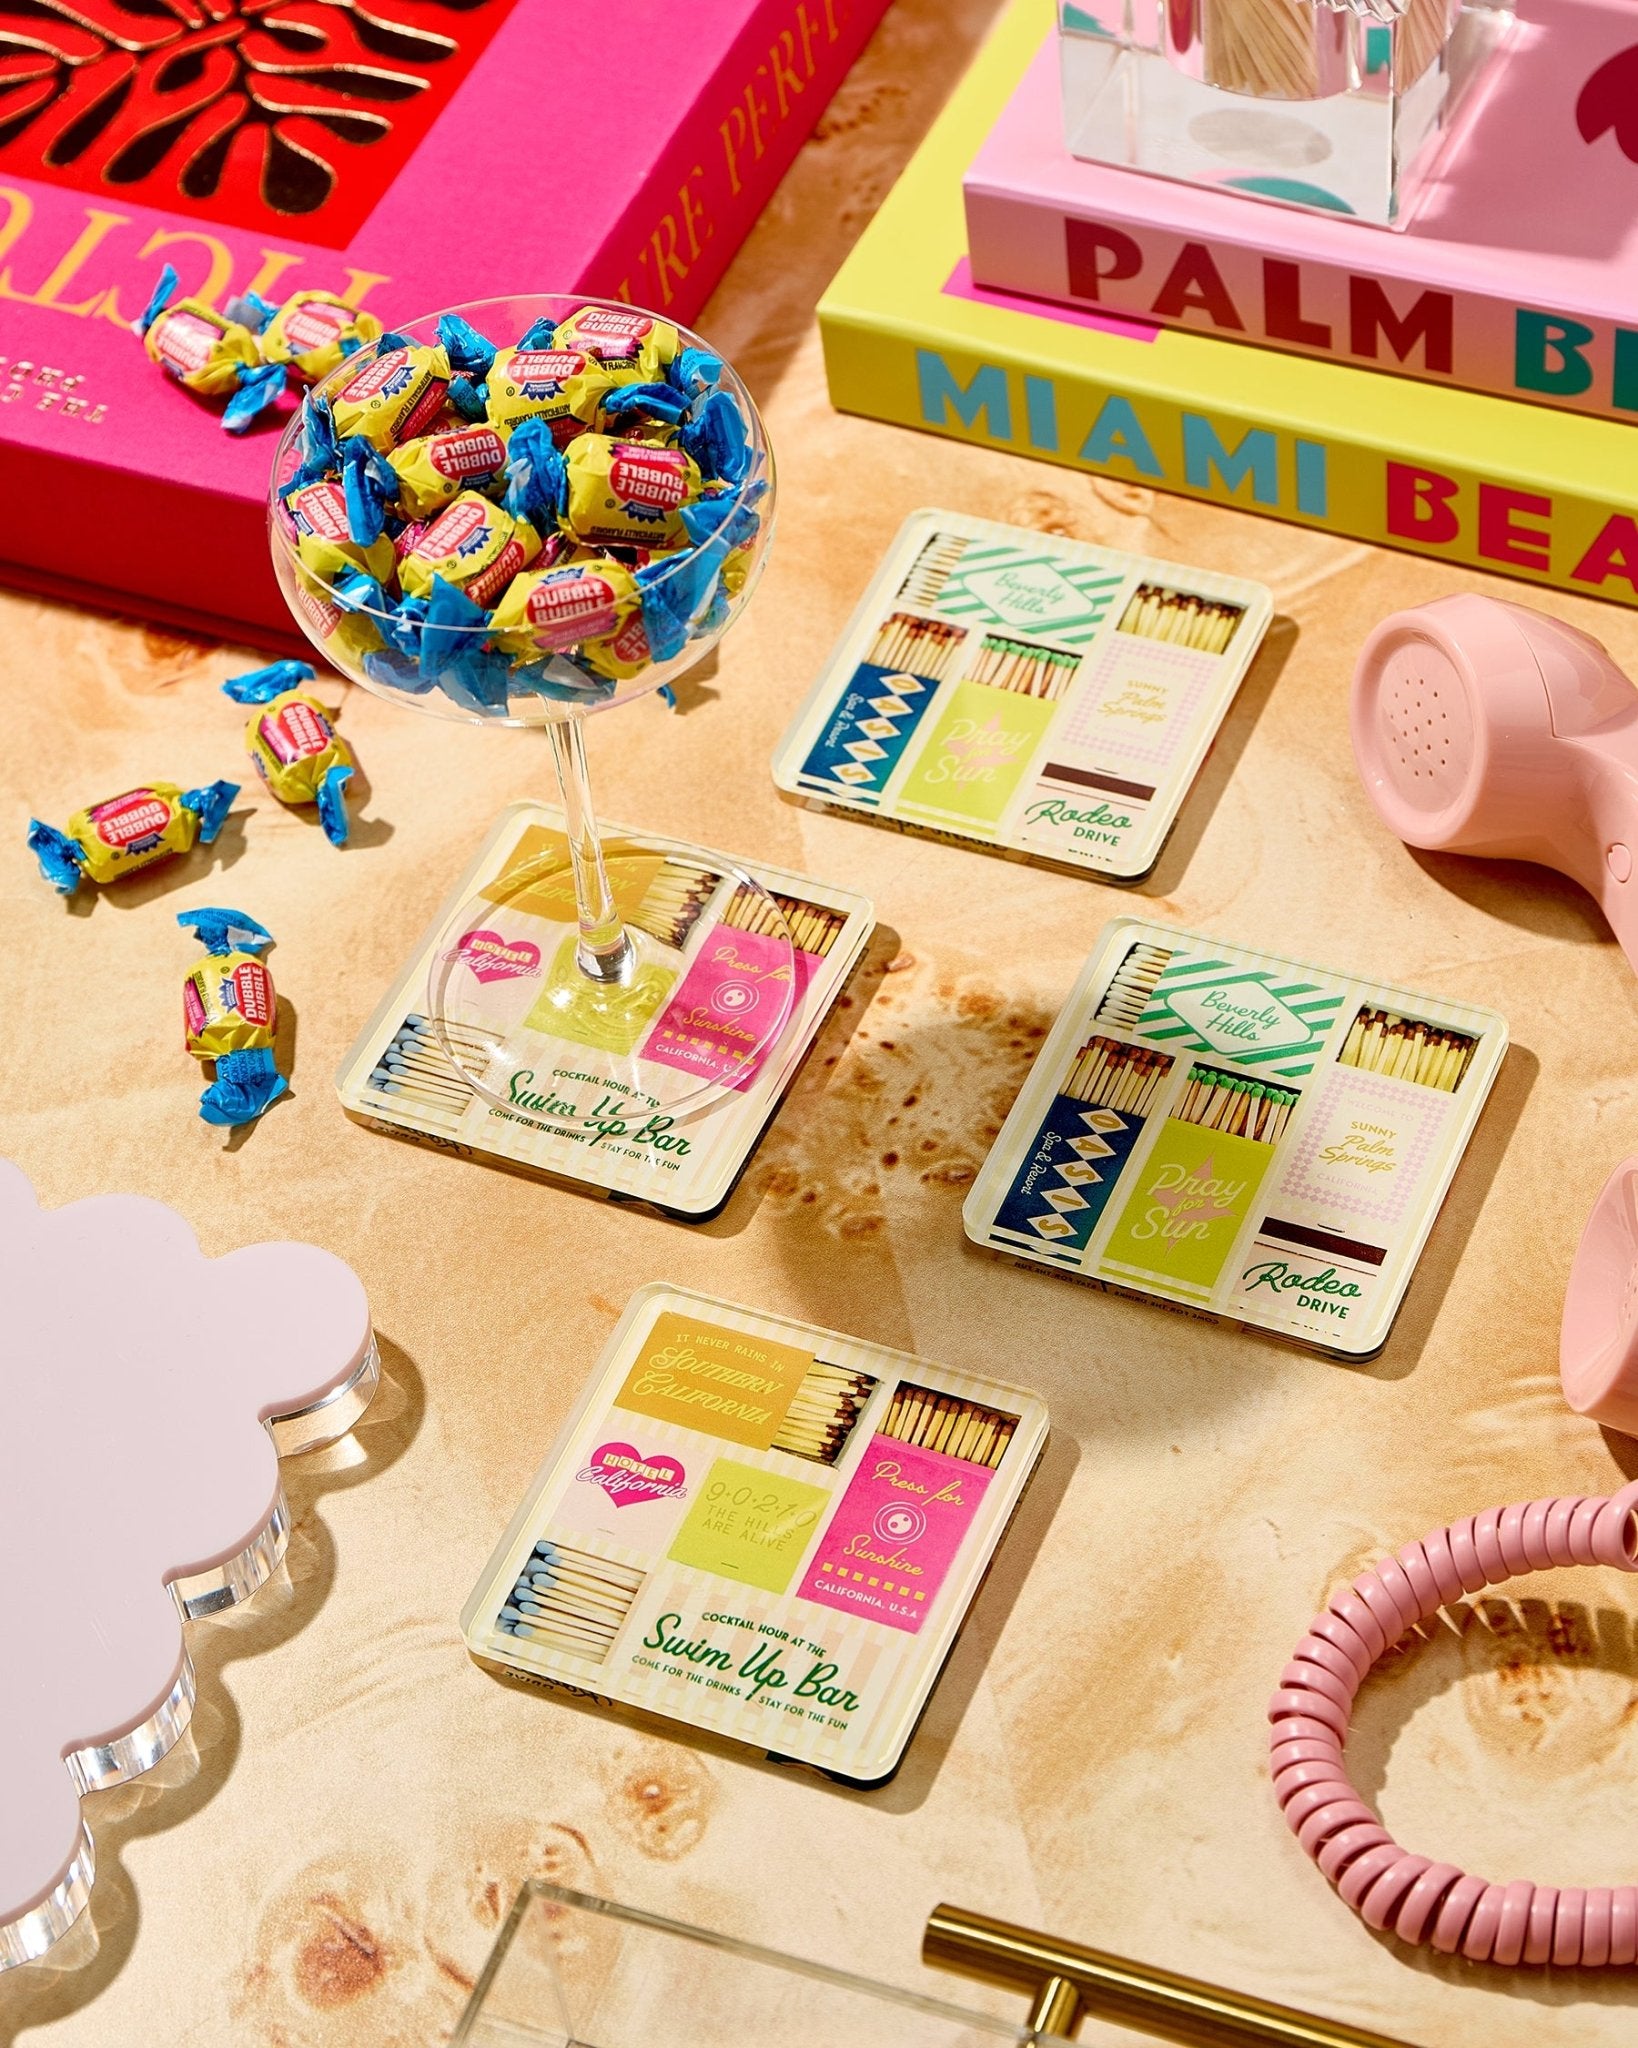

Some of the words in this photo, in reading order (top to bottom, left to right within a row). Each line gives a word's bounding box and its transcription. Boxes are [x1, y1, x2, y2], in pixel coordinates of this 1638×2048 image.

[580, 320, 643, 336] BUBBLE
[587, 311, 646, 328] DUBBLE
[1064, 217, 1454, 375] PALM
[1514, 308, 1638, 412] B
[355, 350, 405, 400] DUBBLE
[437, 433, 498, 456] BUBBLE
[442, 452, 502, 473] DUBBLE
[619, 461, 684, 489] BUBBLE
[916, 347, 1327, 518] MIAMI
[1386, 460, 1638, 586] BEA
[617, 479, 683, 503] DUBBLE
[301, 493, 338, 538] DUBBLE
[420, 504, 470, 550] BUBBLE
[434, 507, 484, 557] DUBBLE
[530, 581, 605, 609] DUBBLE
[994, 573, 1065, 605] Beverly
[1001, 590, 1046, 615] Hills
[534, 597, 606, 625] BUBBLE
[283, 707, 312, 750] BUBBLE
[294, 704, 323, 748] DUBBLE
[940, 720, 1034, 757] Pray
[925, 754, 998, 783] Sun
[102, 801, 162, 831] BUBBLE
[107, 811, 165, 844] DUBBLE
[1026, 798, 1132, 829] Rodeo
[1072, 826, 1121, 847] DRIVE
[442, 949, 542, 978] California
[711, 946, 763, 974] Press
[239, 965, 258, 1018] DUBBLE
[251, 966, 268, 1021] BUBBLE
[683, 1007, 757, 1044] Sunshine
[1199, 990, 1281, 1030] Beverly
[1205, 1013, 1261, 1041] Hills
[552, 1069, 600, 1085] COCKTAIL
[602, 1079, 631, 1095] HOUR
[488, 1107, 514, 1121] COME
[515, 1116, 534, 1128] FOR
[536, 1122, 552, 1133] THE
[553, 1128, 586, 1143] DRINKS
[600, 1142, 622, 1154] STAY
[622, 1147, 642, 1161] FOR
[661, 1159, 681, 1172] FUN
[631, 1114, 692, 1157] Bar
[1044, 1131, 1062, 1154] Spa
[1343, 1134, 1395, 1157] Palm
[1350, 1120, 1398, 1139] SUNNY
[1318, 1146, 1398, 1174] Springs
[1020, 1161, 1047, 1196] Resort
[1146, 1163, 1249, 1209] Pray
[1130, 1205, 1211, 1240] Sun
[1171, 1196, 1206, 1217] for
[1242, 1261, 1363, 1299] Rodeo
[1296, 1294, 1350, 1321] DRIVE
[676, 1334, 690, 1343] IT
[695, 1335, 730, 1351] NEVER
[734, 1346, 768, 1363] RAINS
[769, 1360, 785, 1373] IN
[648, 1346, 784, 1396] SOUTHERN
[632, 1370, 773, 1426] CALIFORNIA
[576, 1465, 687, 1500] California
[603, 1453, 675, 1481] HOTEL
[872, 1461, 929, 1495] Press
[921, 1480, 965, 1506] for
[707, 1504, 738, 1522] THE
[702, 1518, 733, 1535] ARE
[739, 1529, 787, 1551] ALIVE
[843, 1534, 924, 1576] Sunshine
[889, 1602, 919, 1618] U.S.A
[701, 1611, 755, 1630] COCKTAIL
[757, 1624, 789, 1642] HOUR
[791, 1635, 807, 1647] AT
[808, 1641, 827, 1658] THE
[643, 1612, 733, 1672] Swim
[738, 1642, 788, 1701] Up
[792, 1661, 861, 1713] Bar
[631, 1654, 660, 1670] COME
[662, 1663, 683, 1678] FOR
[685, 1671, 704, 1685] THE
[705, 1678, 742, 1697] DRINKS
[759, 1695, 781, 1709] STAY
[783, 1702, 806, 1717] FOR
[807, 1709, 827, 1724] THE
[828, 1717, 848, 1732] FUN
